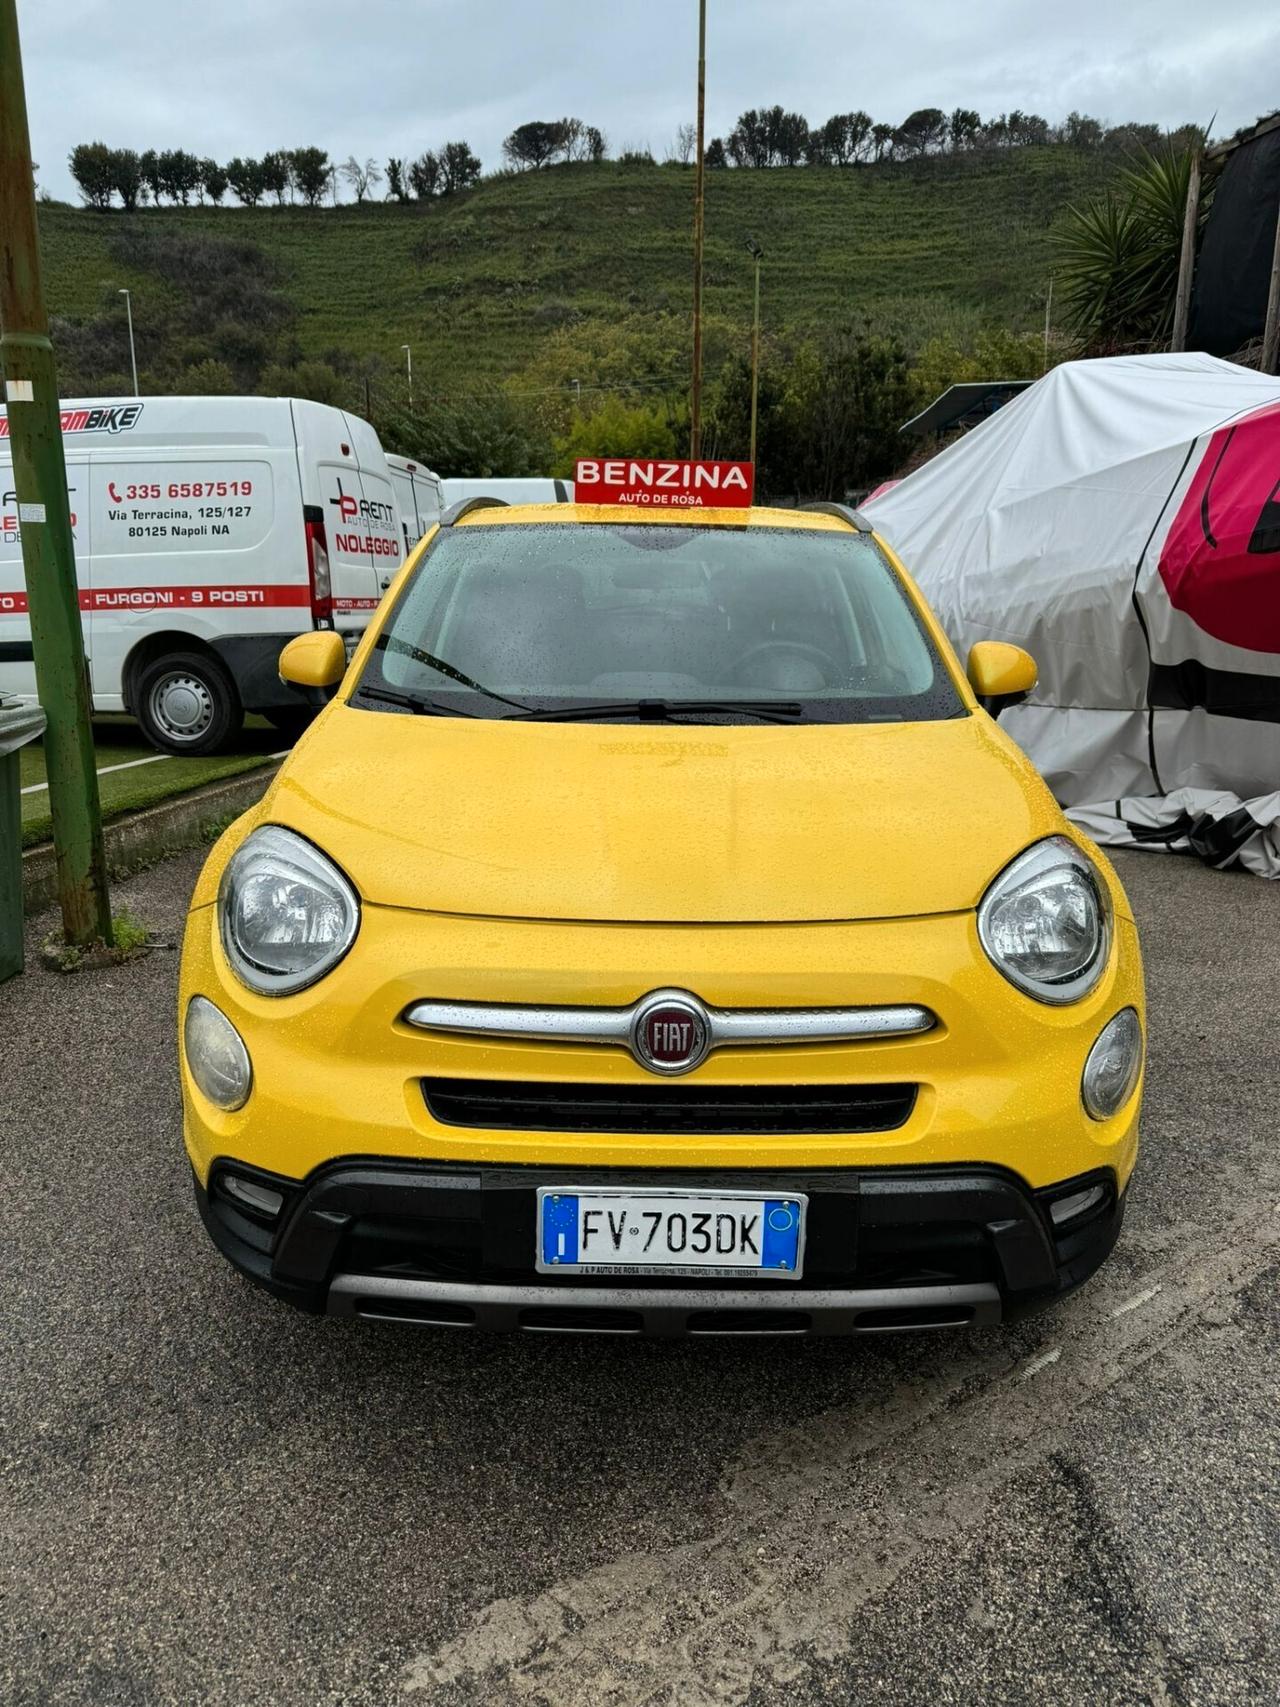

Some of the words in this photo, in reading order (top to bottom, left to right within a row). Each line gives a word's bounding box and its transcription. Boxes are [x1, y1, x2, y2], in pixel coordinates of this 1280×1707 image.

[577, 460, 748, 490] BENZINA
[126, 484, 161, 500] 335
[168, 481, 253, 498] 6587519
[619, 492, 650, 503] AUTO
[653, 493, 668, 504] DE
[671, 494, 703, 505] ROSA
[108, 509, 127, 521] Via
[131, 508, 193, 521] Terracina,
[197, 506, 252, 518] 125/127
[128, 526, 167, 537] 80125
[171, 525, 208, 538] Napoli
[211, 524, 230, 535] NA
[347, 516, 369, 528] AUTO
[370, 519, 379, 529] DE
[380, 521, 396, 532] ROSA
[336, 533, 399, 557] NOLEGGIO
[96, 592, 174, 605] FURGONI
[191, 591, 204, 603] 9
[209, 590, 265, 602] POSTI
[336, 600, 353, 608] MOTO
[356, 600, 370, 608] AUTO
[653, 1022, 691, 1052] FIAT
[596, 1266, 612, 1274] AUTO
[614, 1266, 622, 1274] DE
[623, 1266, 640, 1274] ROSA
